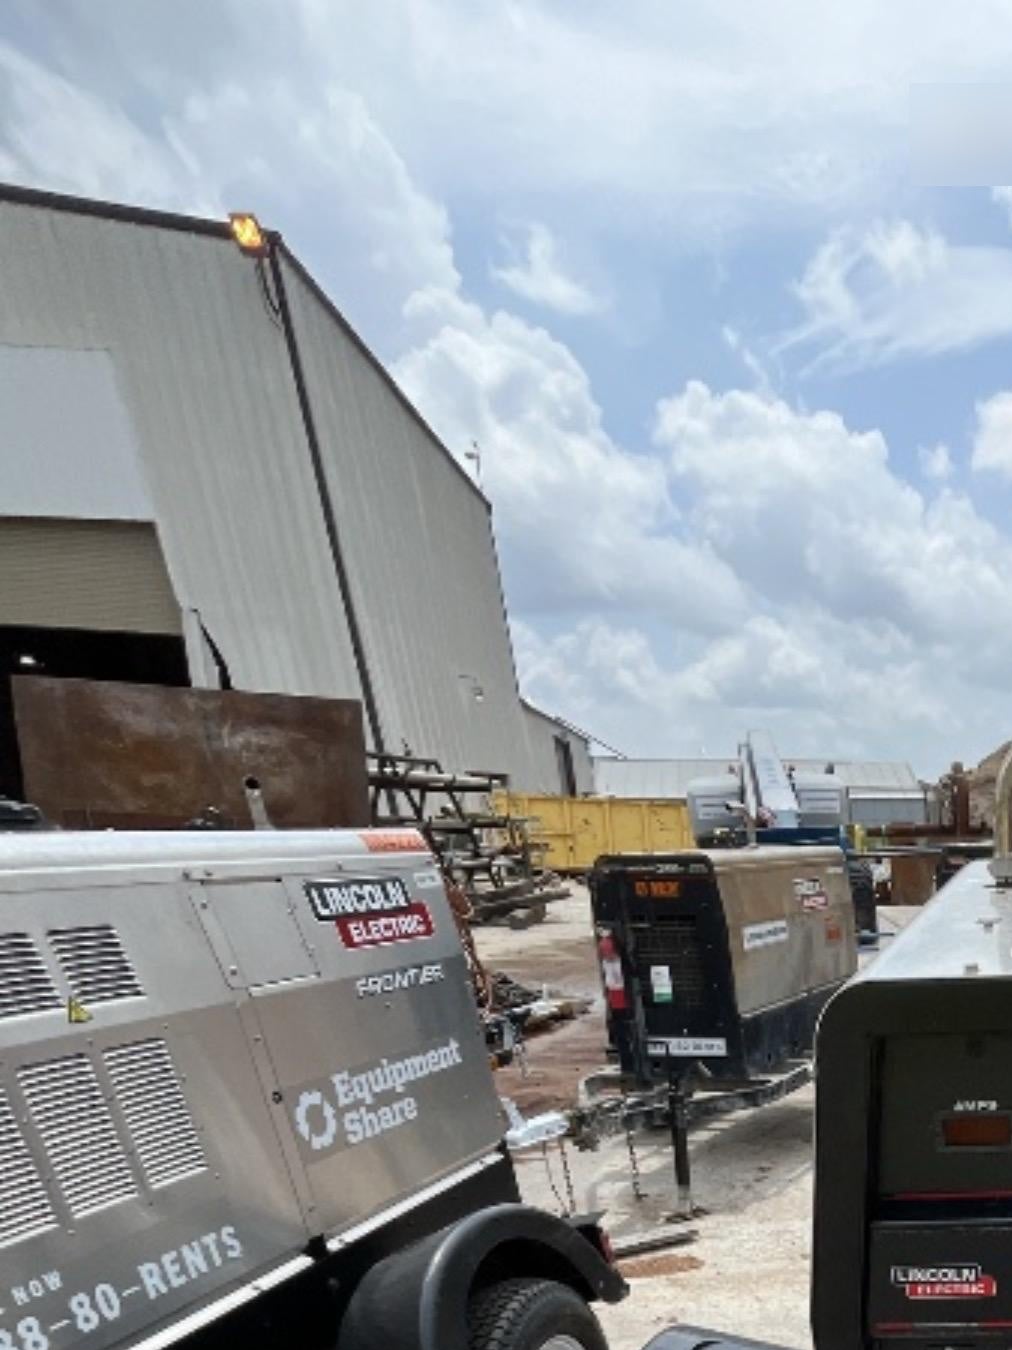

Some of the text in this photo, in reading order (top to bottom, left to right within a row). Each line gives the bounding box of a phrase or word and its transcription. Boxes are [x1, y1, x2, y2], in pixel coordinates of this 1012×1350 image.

[309, 880, 408, 916] LINCOLN
[349, 913, 426, 943] ELECTRIC
[356, 963, 444, 998] FRONTIER
[331, 1037, 463, 1108] Equipment
[344, 1097, 418, 1144] Share
[953, 1100, 998, 1111] AMPS
[11, 1269, 63, 1306] NOW
[897, 1268, 977, 1282] LINCOLN
